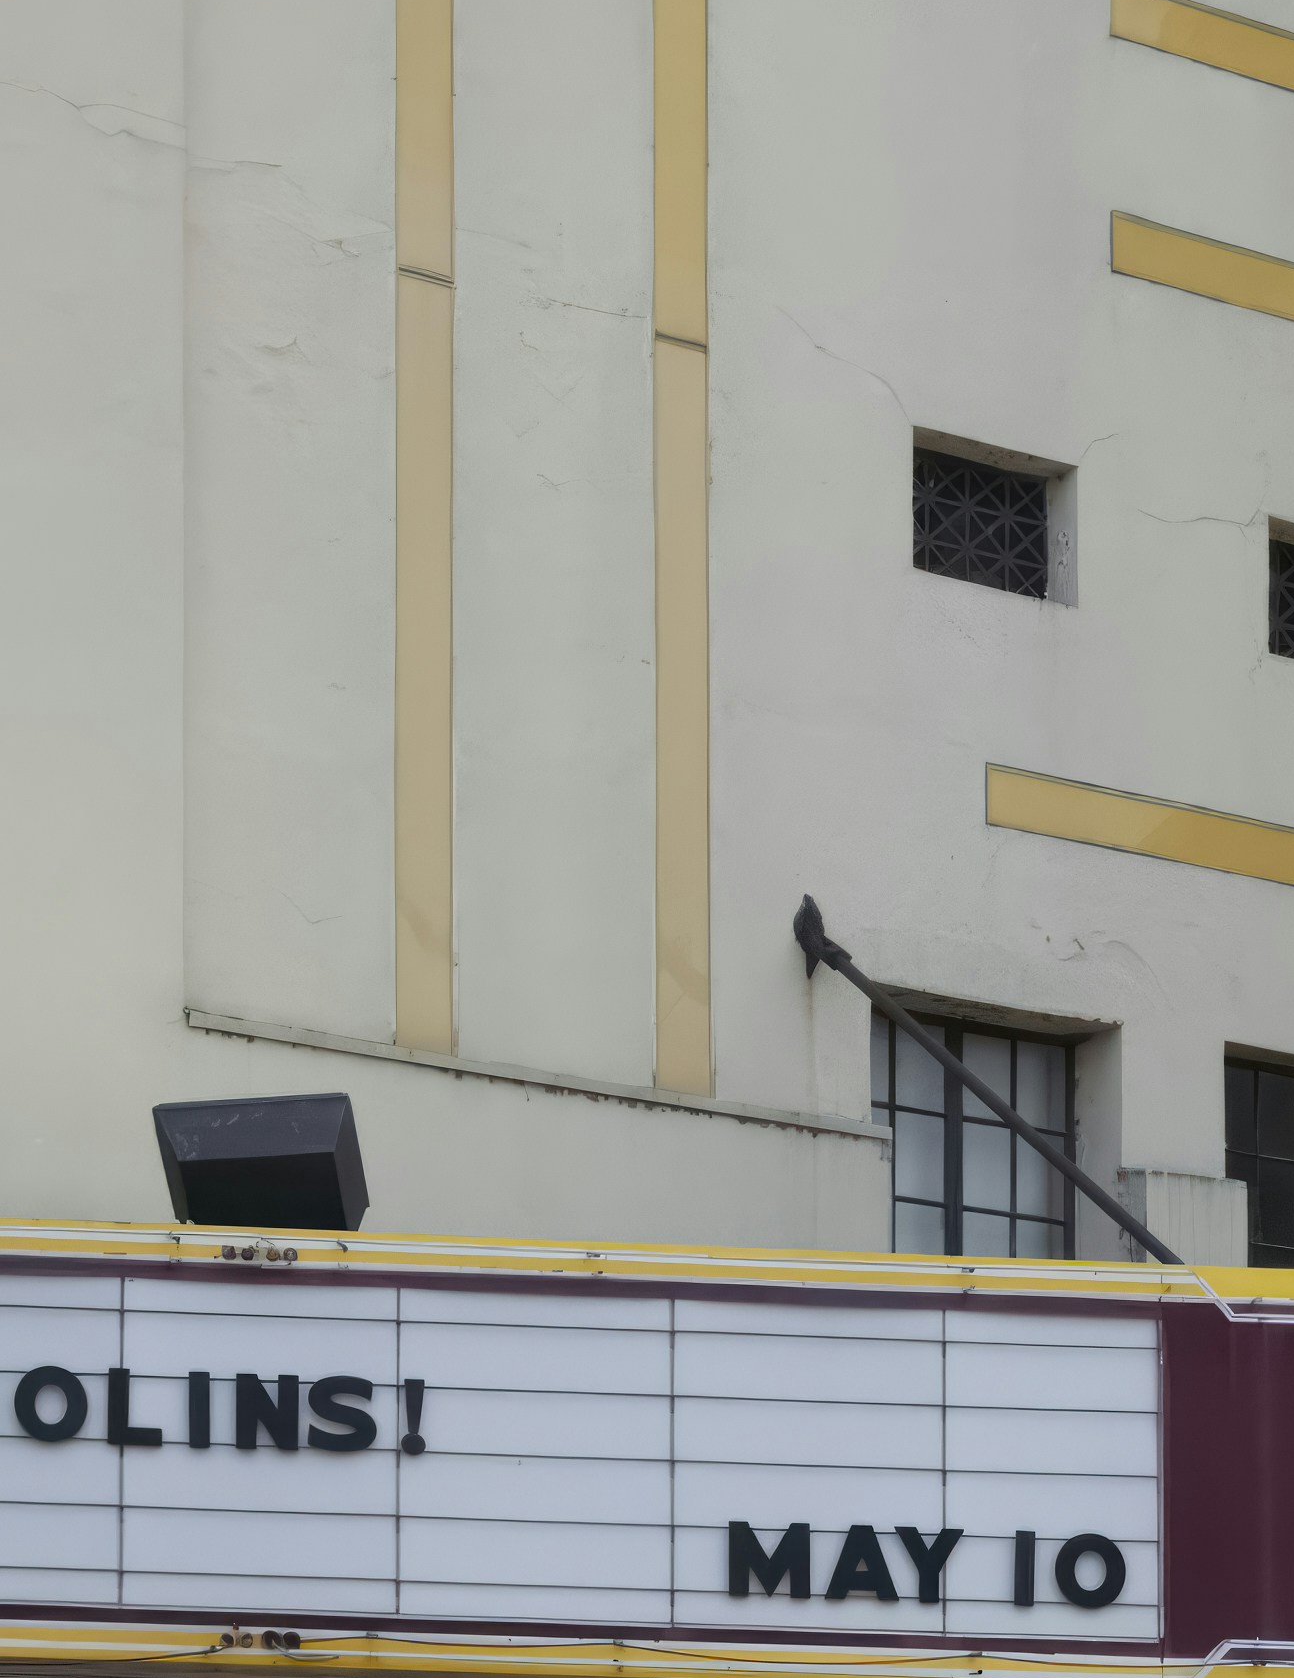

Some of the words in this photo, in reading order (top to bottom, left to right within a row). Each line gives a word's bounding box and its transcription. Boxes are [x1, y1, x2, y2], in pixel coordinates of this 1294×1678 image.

[14, 1364, 427, 1455] OLINS!
[728, 1521, 963, 1604] MAY
[1013, 1530, 1127, 1609] 10
